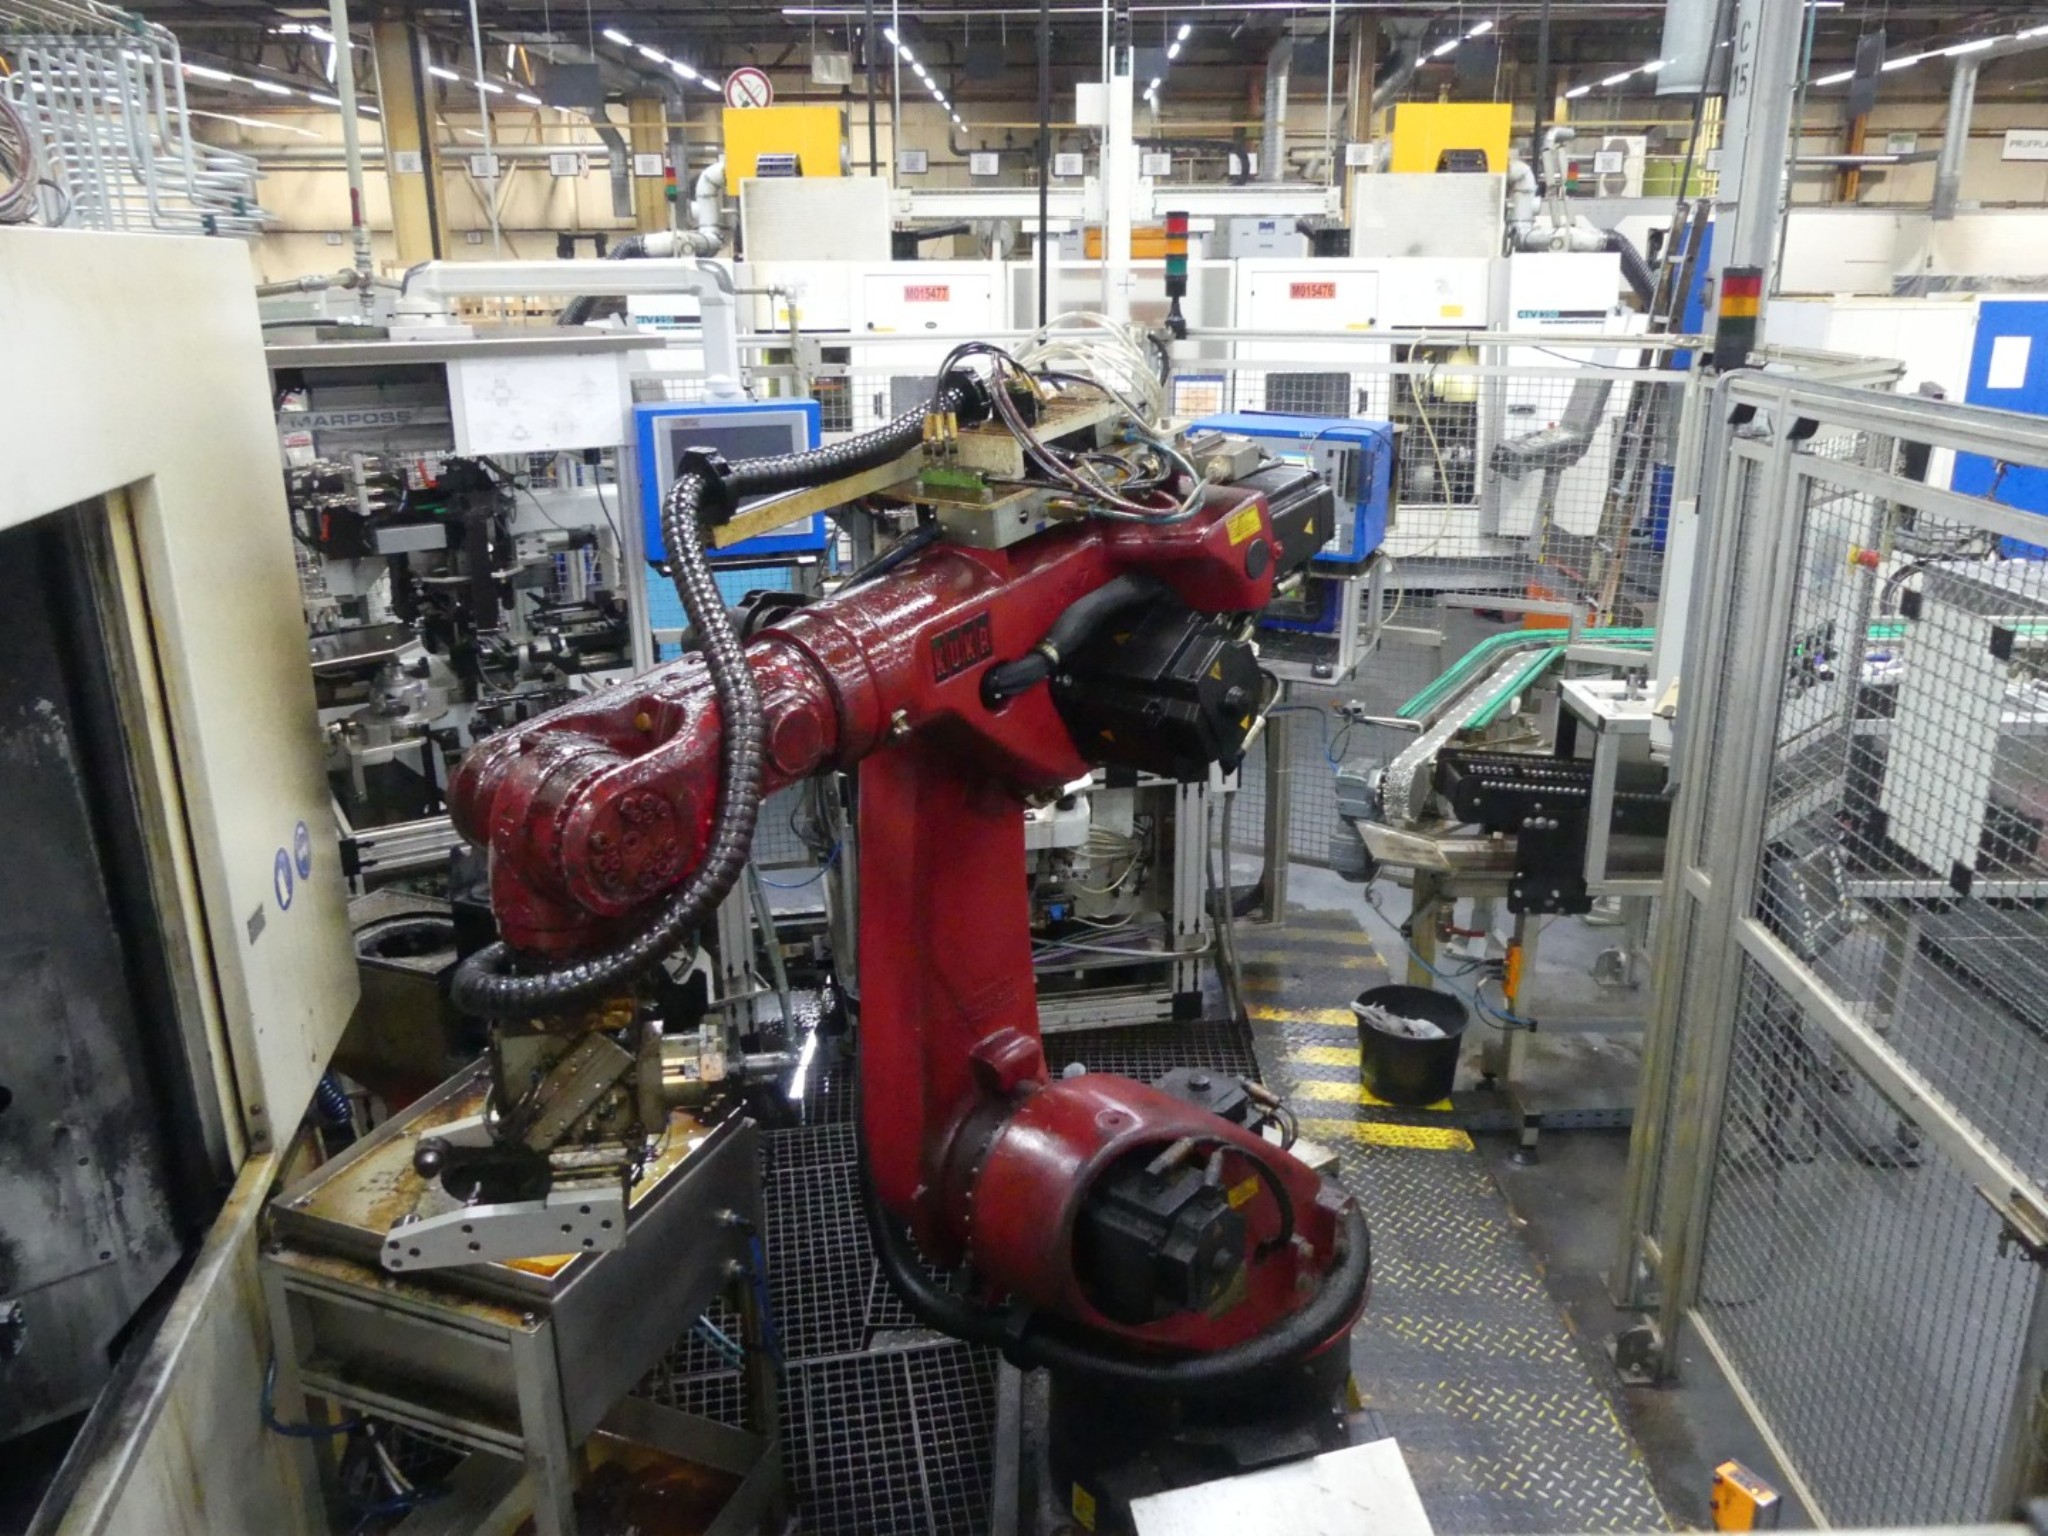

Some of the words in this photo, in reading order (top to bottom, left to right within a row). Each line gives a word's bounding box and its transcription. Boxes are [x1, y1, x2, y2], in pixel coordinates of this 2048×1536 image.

[1740, 21, 1752, 53] C
[1731, 62, 1750, 98] 15
[905, 286, 949, 300] M015477
[290, 410, 413, 429] MARPOSS
[933, 618, 991, 681] KUKA
